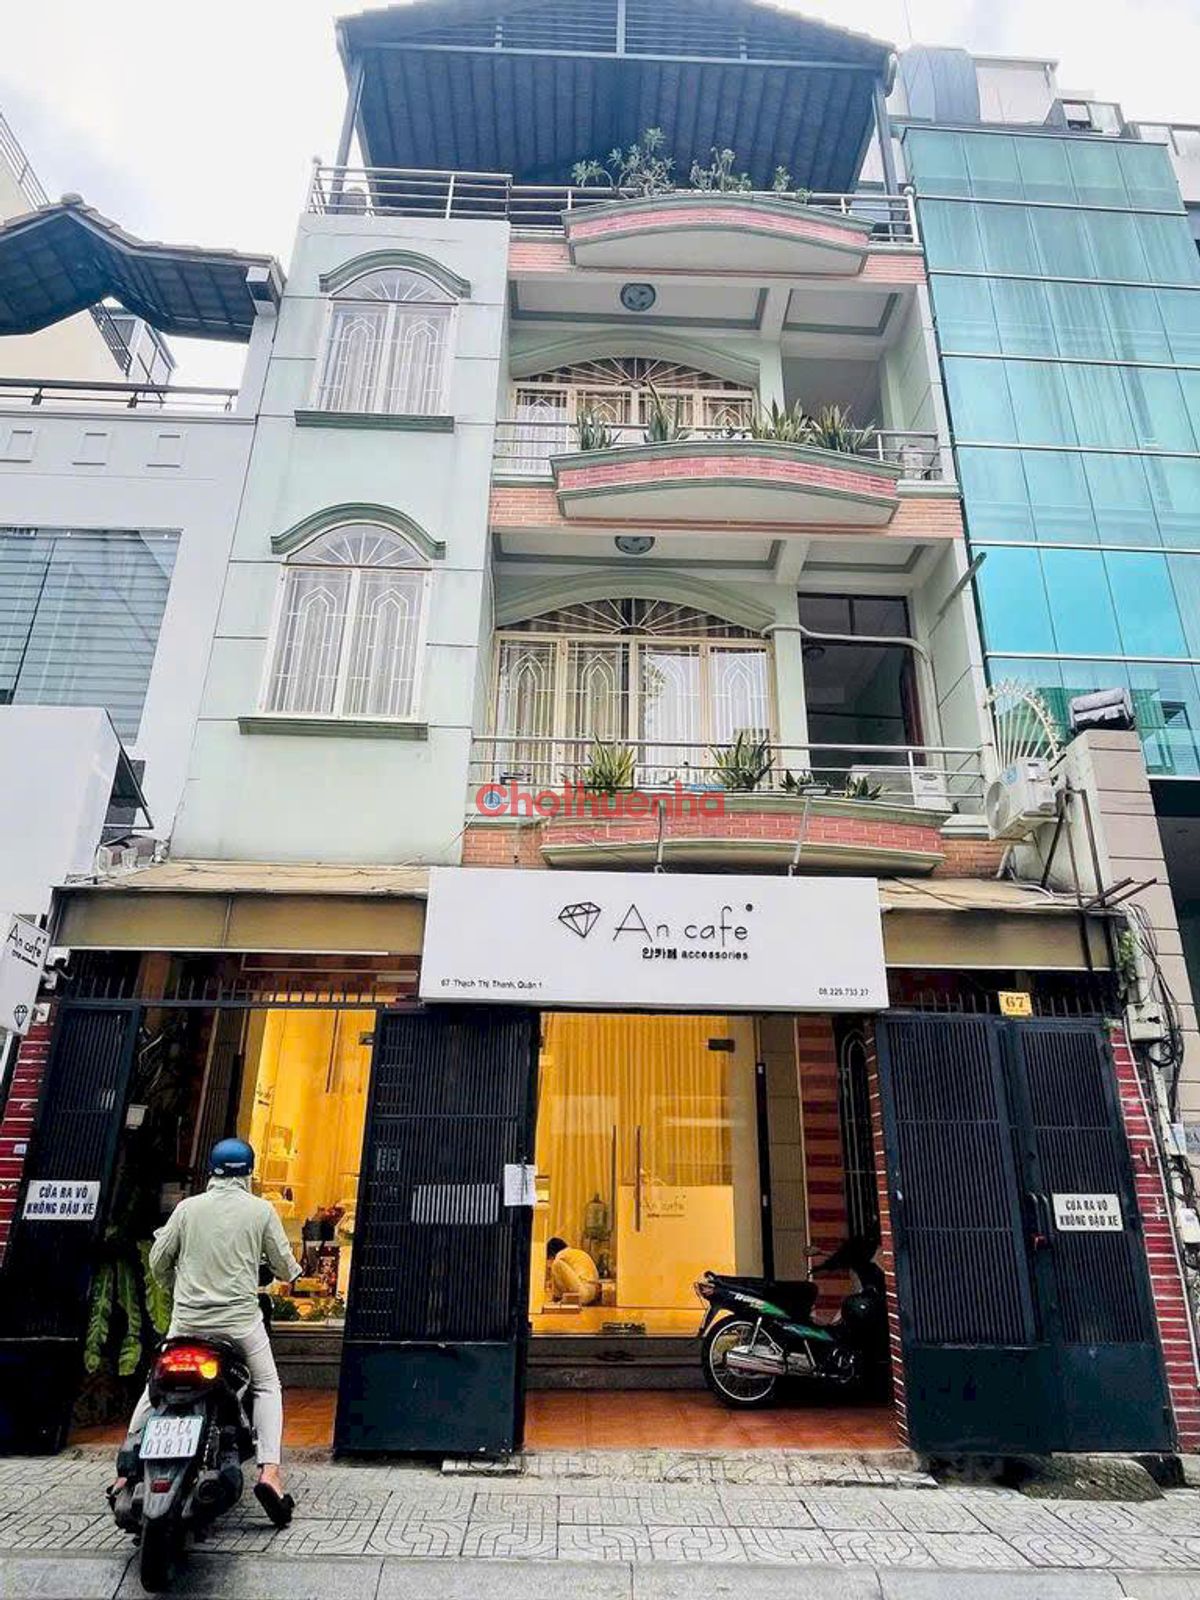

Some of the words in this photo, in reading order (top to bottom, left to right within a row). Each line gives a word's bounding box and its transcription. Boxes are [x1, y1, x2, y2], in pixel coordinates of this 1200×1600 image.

[612, 903, 670, 942] An
[7, 922, 23, 948] An
[681, 950, 749, 961] accessories
[1006, 996, 1024, 1008] 67
[60, 1187, 73, 1199] RA
[81, 1203, 95, 1215] XE
[1107, 1215, 1119, 1227] XE
